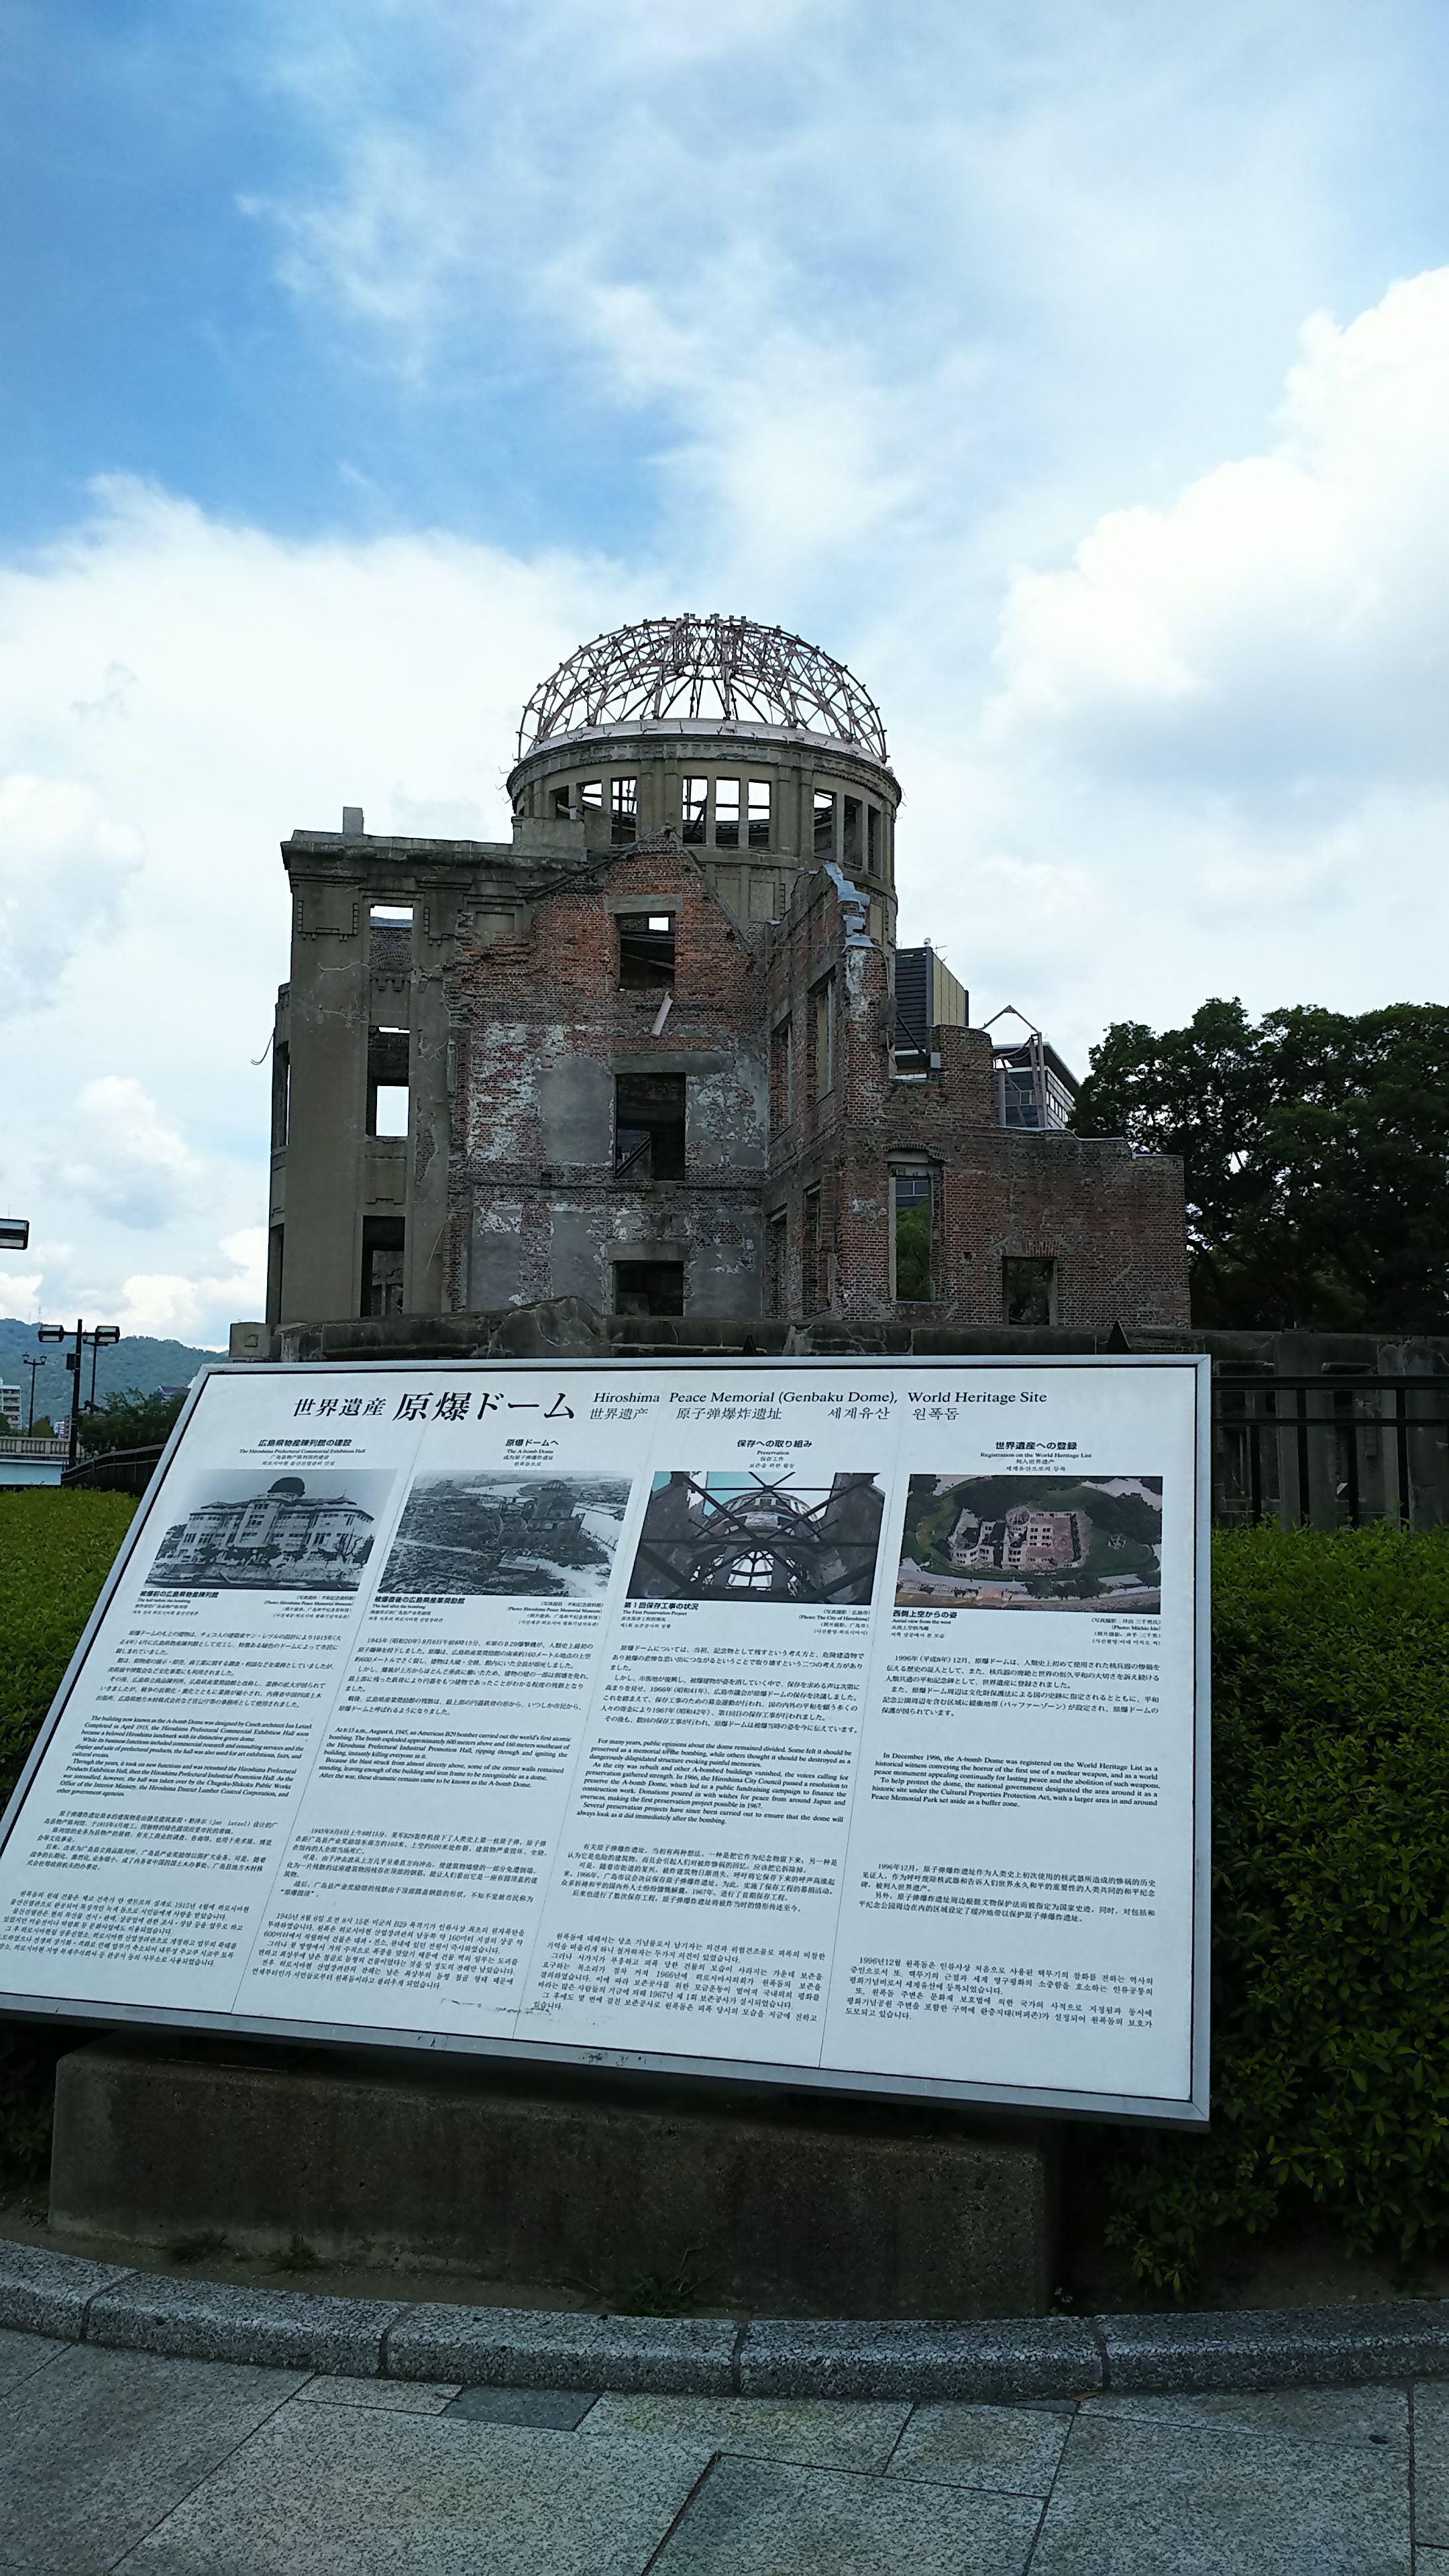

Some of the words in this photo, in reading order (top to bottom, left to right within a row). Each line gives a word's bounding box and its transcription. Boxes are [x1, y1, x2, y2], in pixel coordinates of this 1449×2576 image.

[594, 1393, 659, 1402] Hiroshima
[669, 1393, 706, 1402] Peace
[710, 1392, 774, 1402] Memorial
[779, 1391, 843, 1403] (Genbaku
[848, 1391, 897, 1403] Dome),
[908, 1392, 951, 1402] World
[955, 1392, 1016, 1405] Heritage
[1020, 1392, 1046, 1402] Site
[294, 1398, 386, 1417] 世界遺産
[392, 1392, 574, 1421] 原爆ドーム
[590, 1408, 648, 1419] 世界遗产
[676, 1407, 782, 1419] 原子弹爆炸遗址
[828, 1407, 890, 1419] 세계유산
[912, 1408, 959, 1420] 원폭돔
[737, 1440, 812, 1448] 保存への取り組み
[996, 1442, 1077, 1450] 世界遺産への登録
[893, 1610, 957, 1619] 西側上空からの姿
[892, 1752, 924, 1760] December
[1019, 1759, 1051, 1767] registered
[1099, 1762, 1128, 1771] Heritage
[725, 1768, 753, 1776] buildings
[755, 1770, 782, 1778] vanished,
[816, 1773, 837, 1781] calling
[928, 1772, 959, 1780] appealing
[959, 1774, 995, 1782] continually
[1006, 1774, 1028, 1783] lasting
